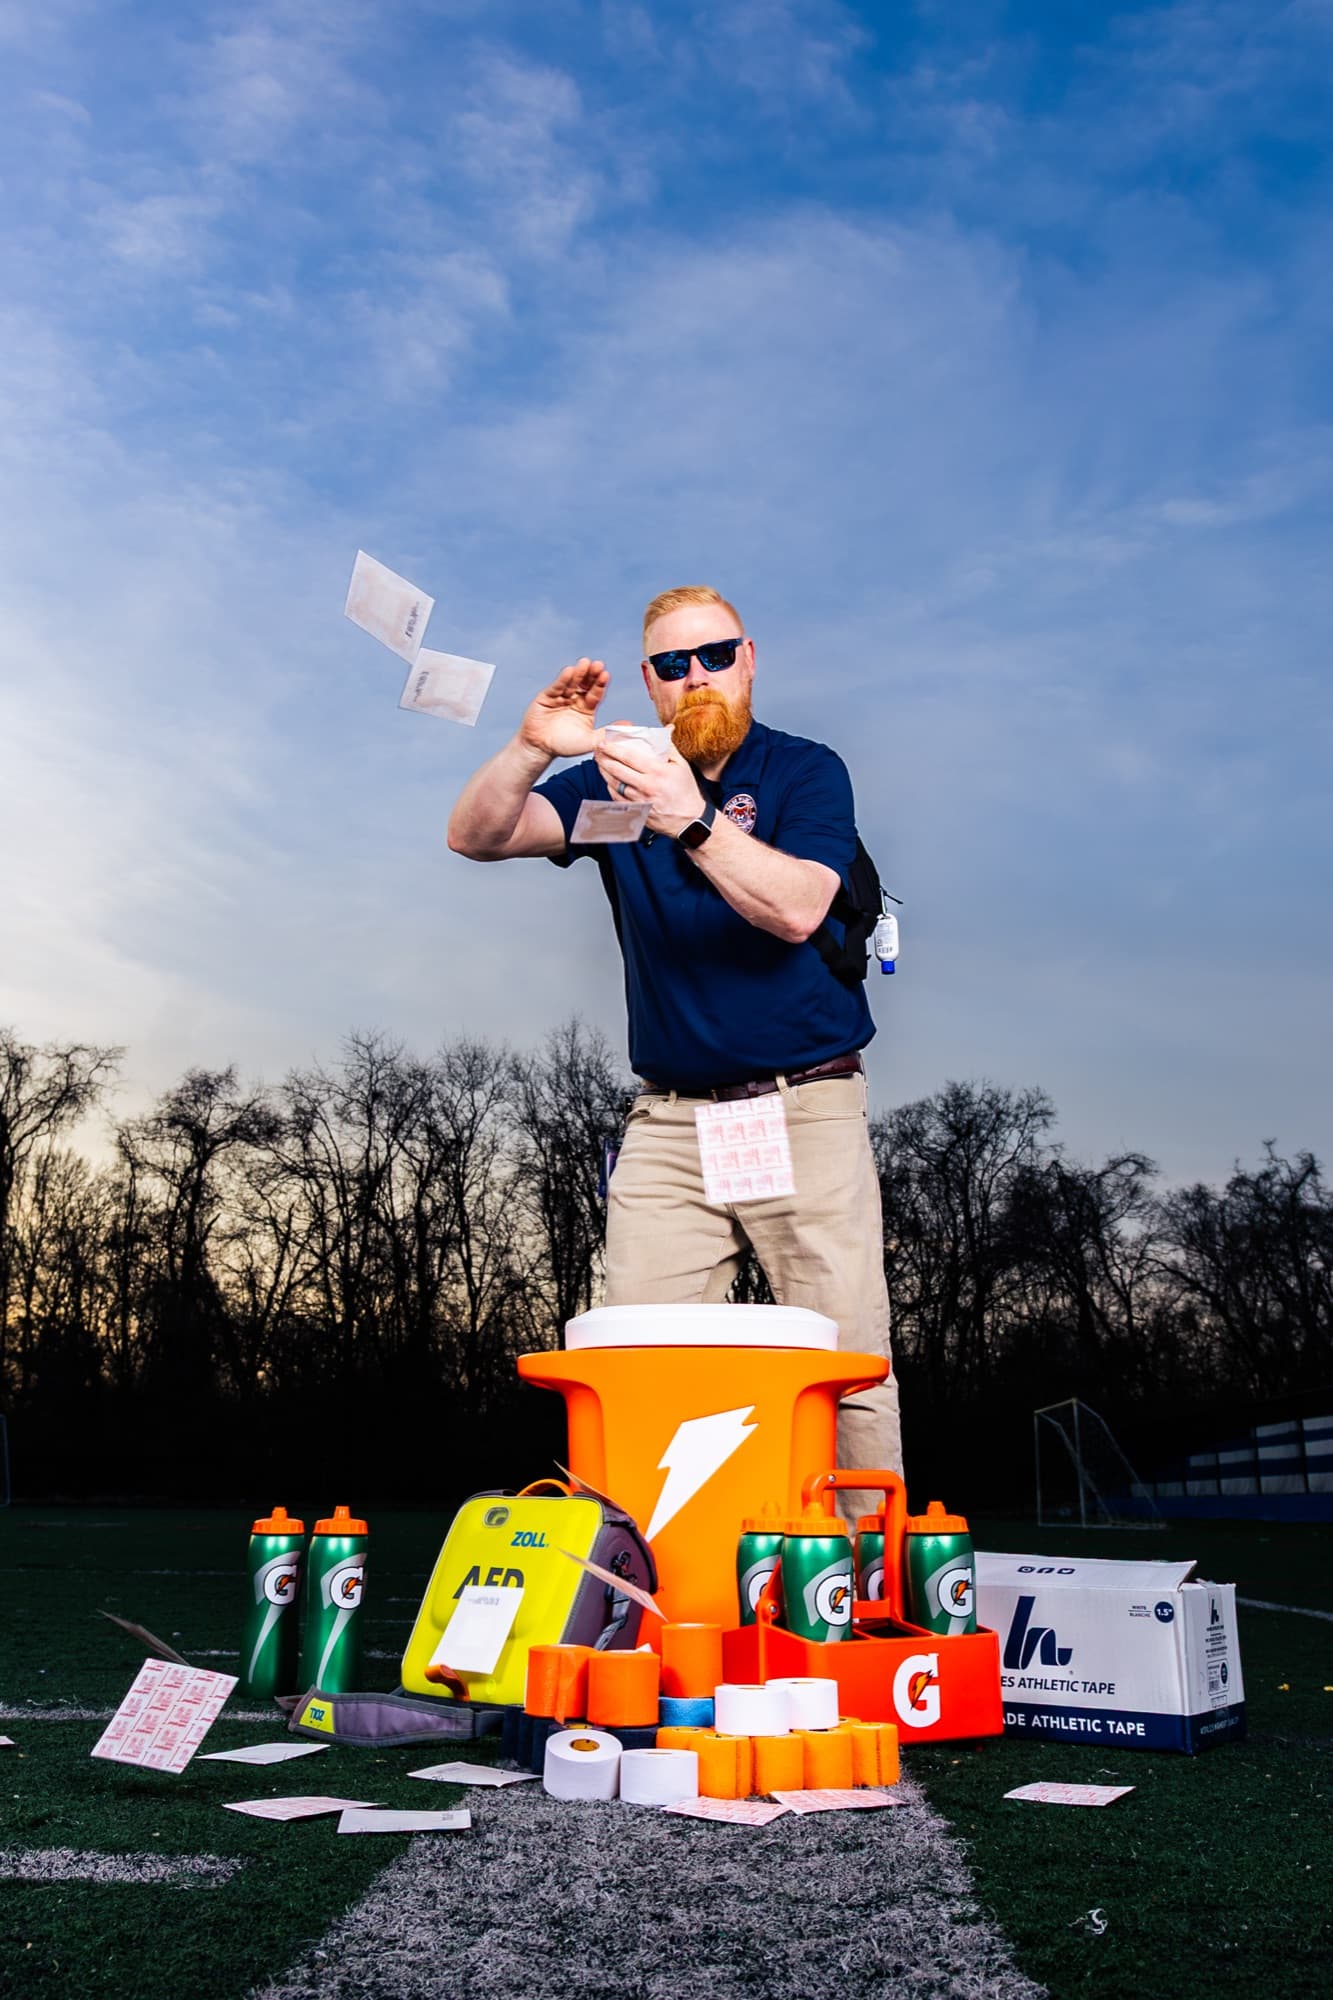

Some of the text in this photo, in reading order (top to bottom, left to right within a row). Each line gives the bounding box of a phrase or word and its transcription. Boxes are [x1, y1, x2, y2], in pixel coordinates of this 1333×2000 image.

[511, 1531, 546, 1548] ZOLL
[264, 1564, 297, 1606] G
[330, 1566, 364, 1610] G
[815, 1573, 850, 1627] G
[937, 1567, 974, 1618] G
[893, 1653, 941, 1728] G
[1018, 1677, 1079, 1693] ATHLETIC
[1081, 1681, 1116, 1695] TAPE
[1031, 1715, 1102, 1733] ATHLETIC
[1106, 1720, 1146, 1736] TAPE
